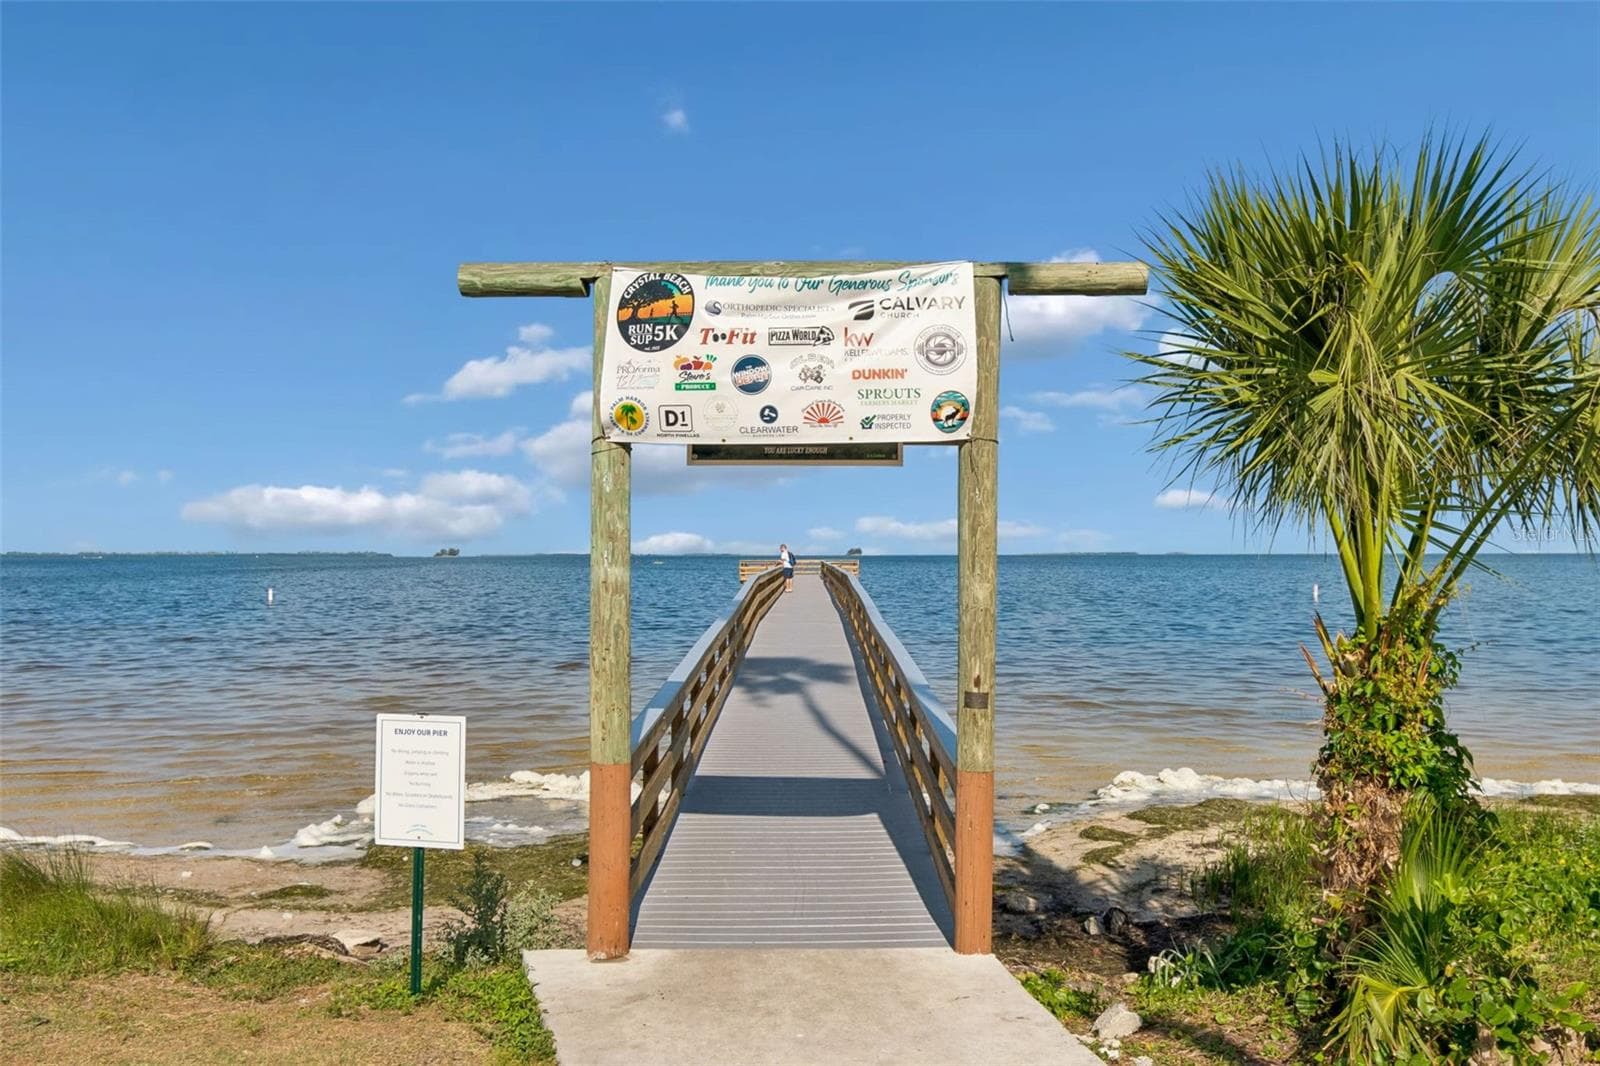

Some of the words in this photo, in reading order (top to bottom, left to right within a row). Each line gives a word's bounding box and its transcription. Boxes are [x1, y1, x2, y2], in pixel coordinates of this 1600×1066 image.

[623, 272, 660, 299] CRYSTAL
[663, 272, 692, 294] BEACH
[704, 275, 745, 290] Thank
[748, 276, 774, 293] you
[795, 276, 824, 292] Our
[828, 275, 892, 296] Generous
[897, 270, 959, 291] Sponsors
[723, 303, 781, 312] ORTHOPEDIC
[880, 296, 966, 311] CALVARY
[628, 323, 653, 336] RUN
[654, 324, 679, 341] 5K
[771, 330, 791, 341] PIZZA
[844, 327, 874, 347] kw
[630, 334, 653, 345] SUP
[852, 368, 908, 380] DUNKIN'
[857, 388, 921, 400] SPROUTS
[877, 413, 912, 421] PROPERLY
[739, 425, 799, 434] CLEARWATER
[875, 422, 912, 430] INSPECTED
[394, 728, 415, 736] ENJOY
[416, 728, 431, 736] OUR
[432, 729, 448, 737] PIER
